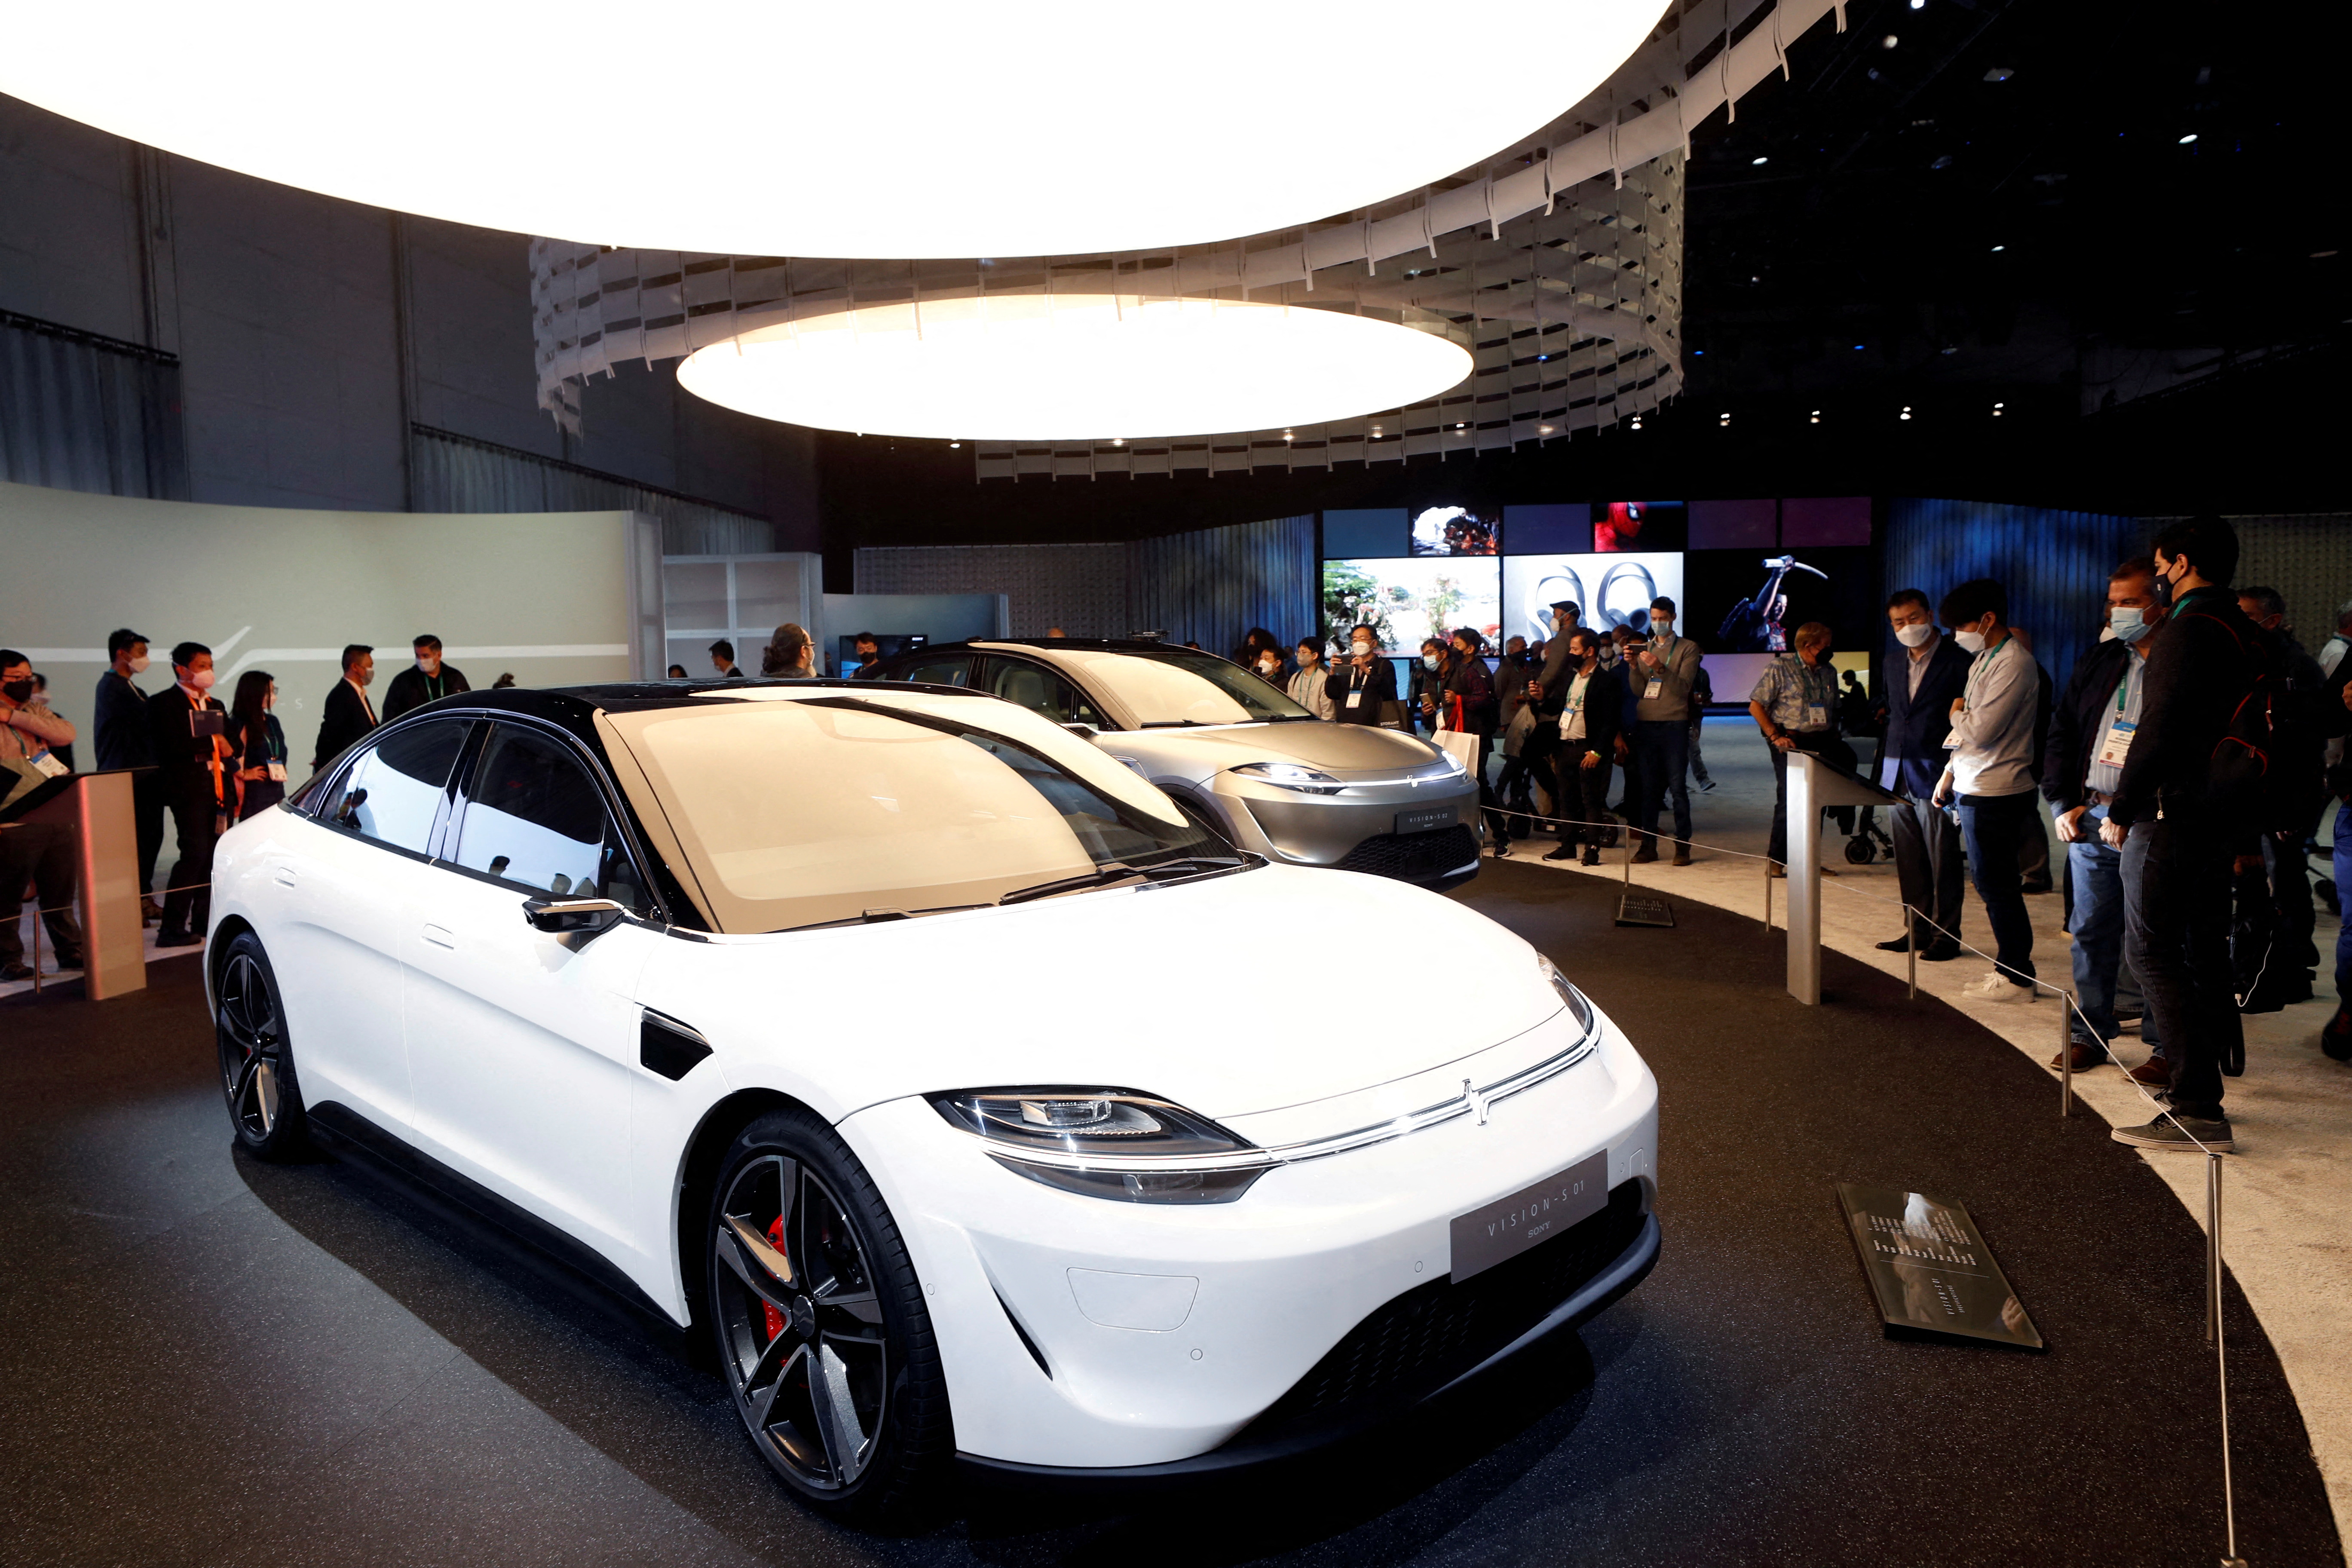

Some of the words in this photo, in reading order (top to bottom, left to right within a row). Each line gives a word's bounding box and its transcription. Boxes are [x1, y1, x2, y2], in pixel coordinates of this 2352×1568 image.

[1409, 814, 1440, 822] VISION-S
[1488, 1188, 1567, 1236] VISION-S
[1574, 1180, 1583, 1195] 01
[1528, 1221, 1551, 1238] SONY
[1947, 1285, 1965, 1313] SPECIFICATIONS
